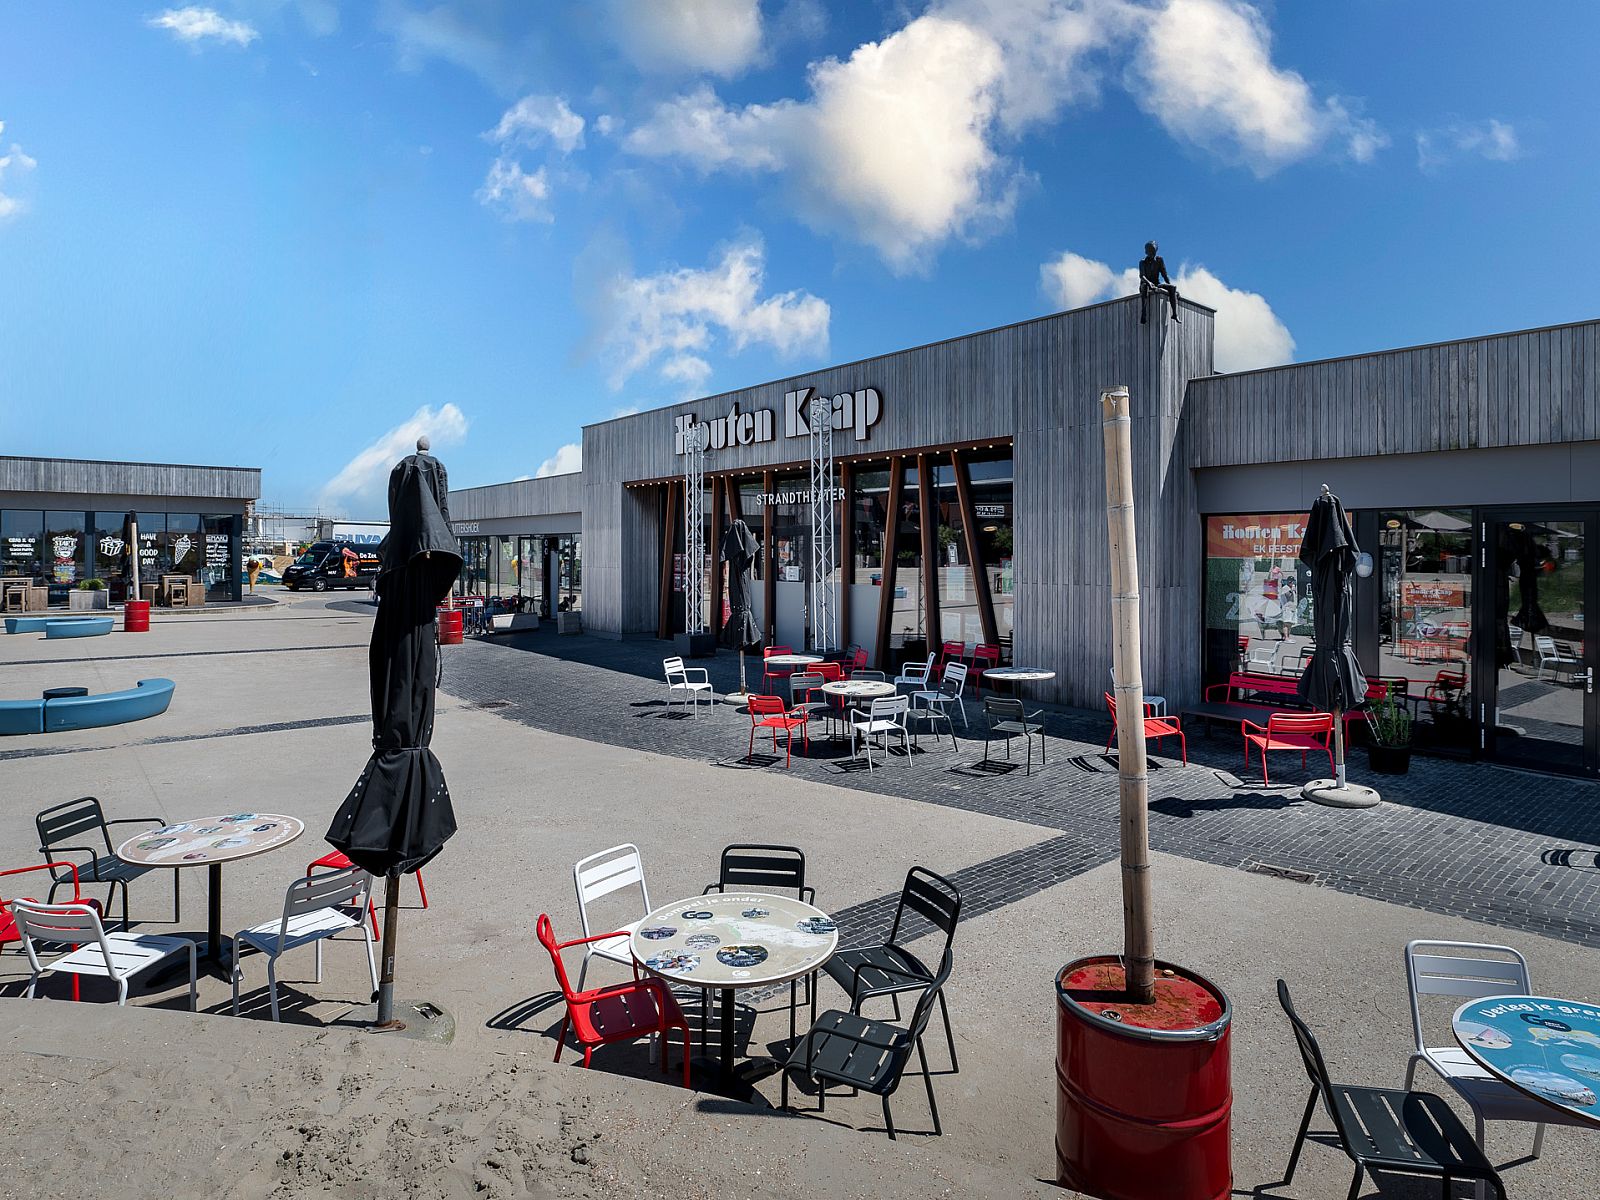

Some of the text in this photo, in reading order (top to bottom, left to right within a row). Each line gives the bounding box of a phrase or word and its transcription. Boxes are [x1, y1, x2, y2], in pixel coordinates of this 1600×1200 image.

[675, 401, 775, 455] Houten
[756, 487, 847, 506] STRANDTHEATER
[140, 533, 156, 541] HAVE
[1223, 523, 1307, 540] Houten Ka
[146, 540, 152, 548] A
[1269, 543, 1302, 554] FEEST
[139, 548, 159, 557] GOOD
[142, 557, 156, 565] DAY
[657, 899, 704, 921] Dompel
[705, 898, 719, 906] je
[1479, 1002, 1534, 1018] Verleg
[1557, 1004, 1600, 1018] gre
